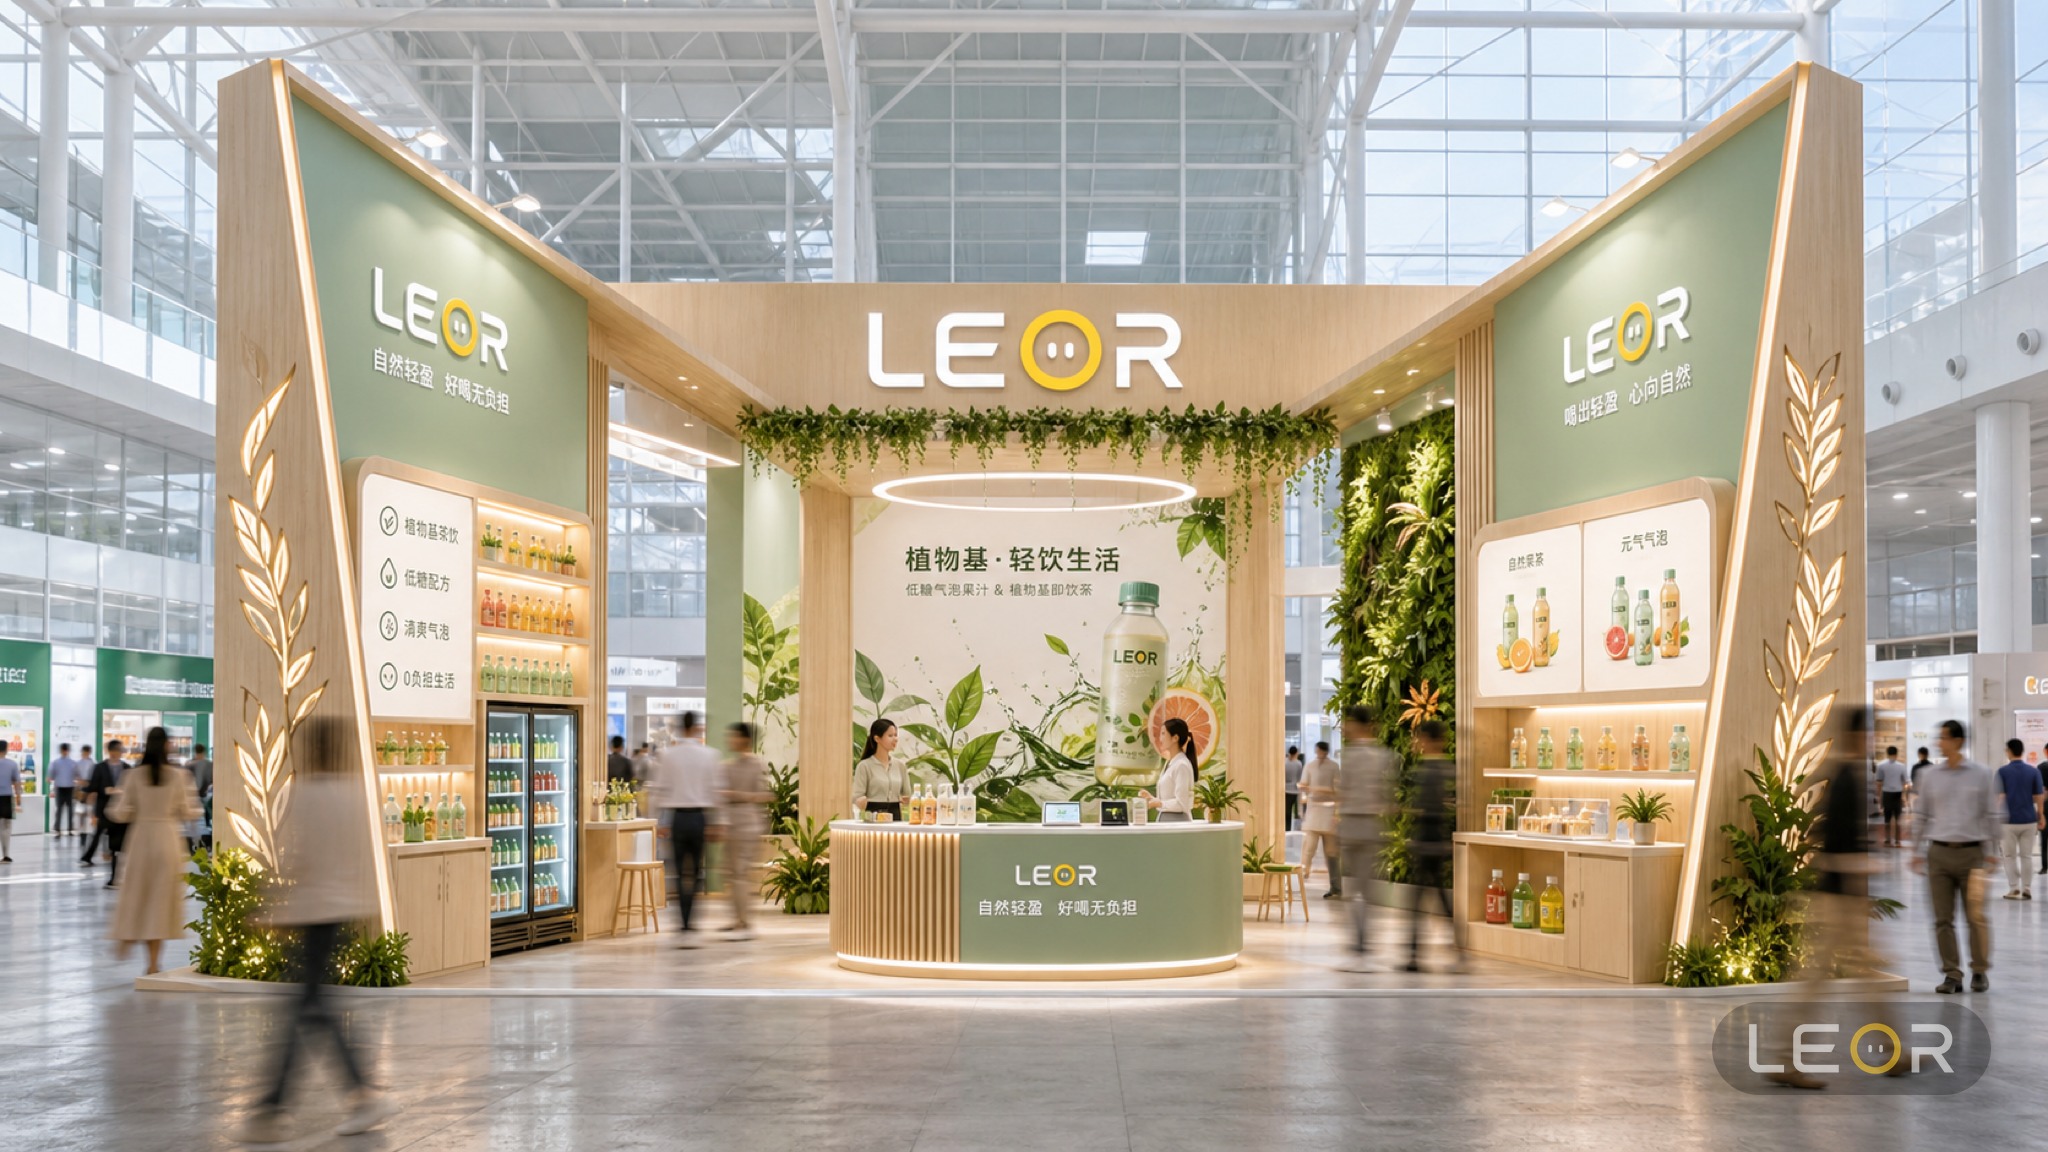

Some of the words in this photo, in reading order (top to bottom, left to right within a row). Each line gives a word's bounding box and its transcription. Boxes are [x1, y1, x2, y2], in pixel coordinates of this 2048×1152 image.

[374, 266, 509, 372] LEOR
[1563, 286, 1690, 384] LEOR
[868, 309, 1184, 391] LEOR
[374, 347, 434, 389] 自然轻盈
[444, 372, 510, 415] 好喝无负担
[1564, 389, 1618, 427] 喝出轻盈
[1628, 363, 1692, 406] 心向自然
[1621, 529, 1668, 553] 元气气泡
[905, 546, 1120, 573] 植物基·轻饮生活
[404, 568, 451, 593] 低糖配方
[994, 585, 1004, 597] &
[404, 618, 450, 641] 清爽气泡
[1113, 649, 1158, 666] LEOR
[403, 670, 455, 690] 0负担生活
[1015, 863, 1097, 887] LEOR
[979, 899, 1043, 916] 自然轻盈
